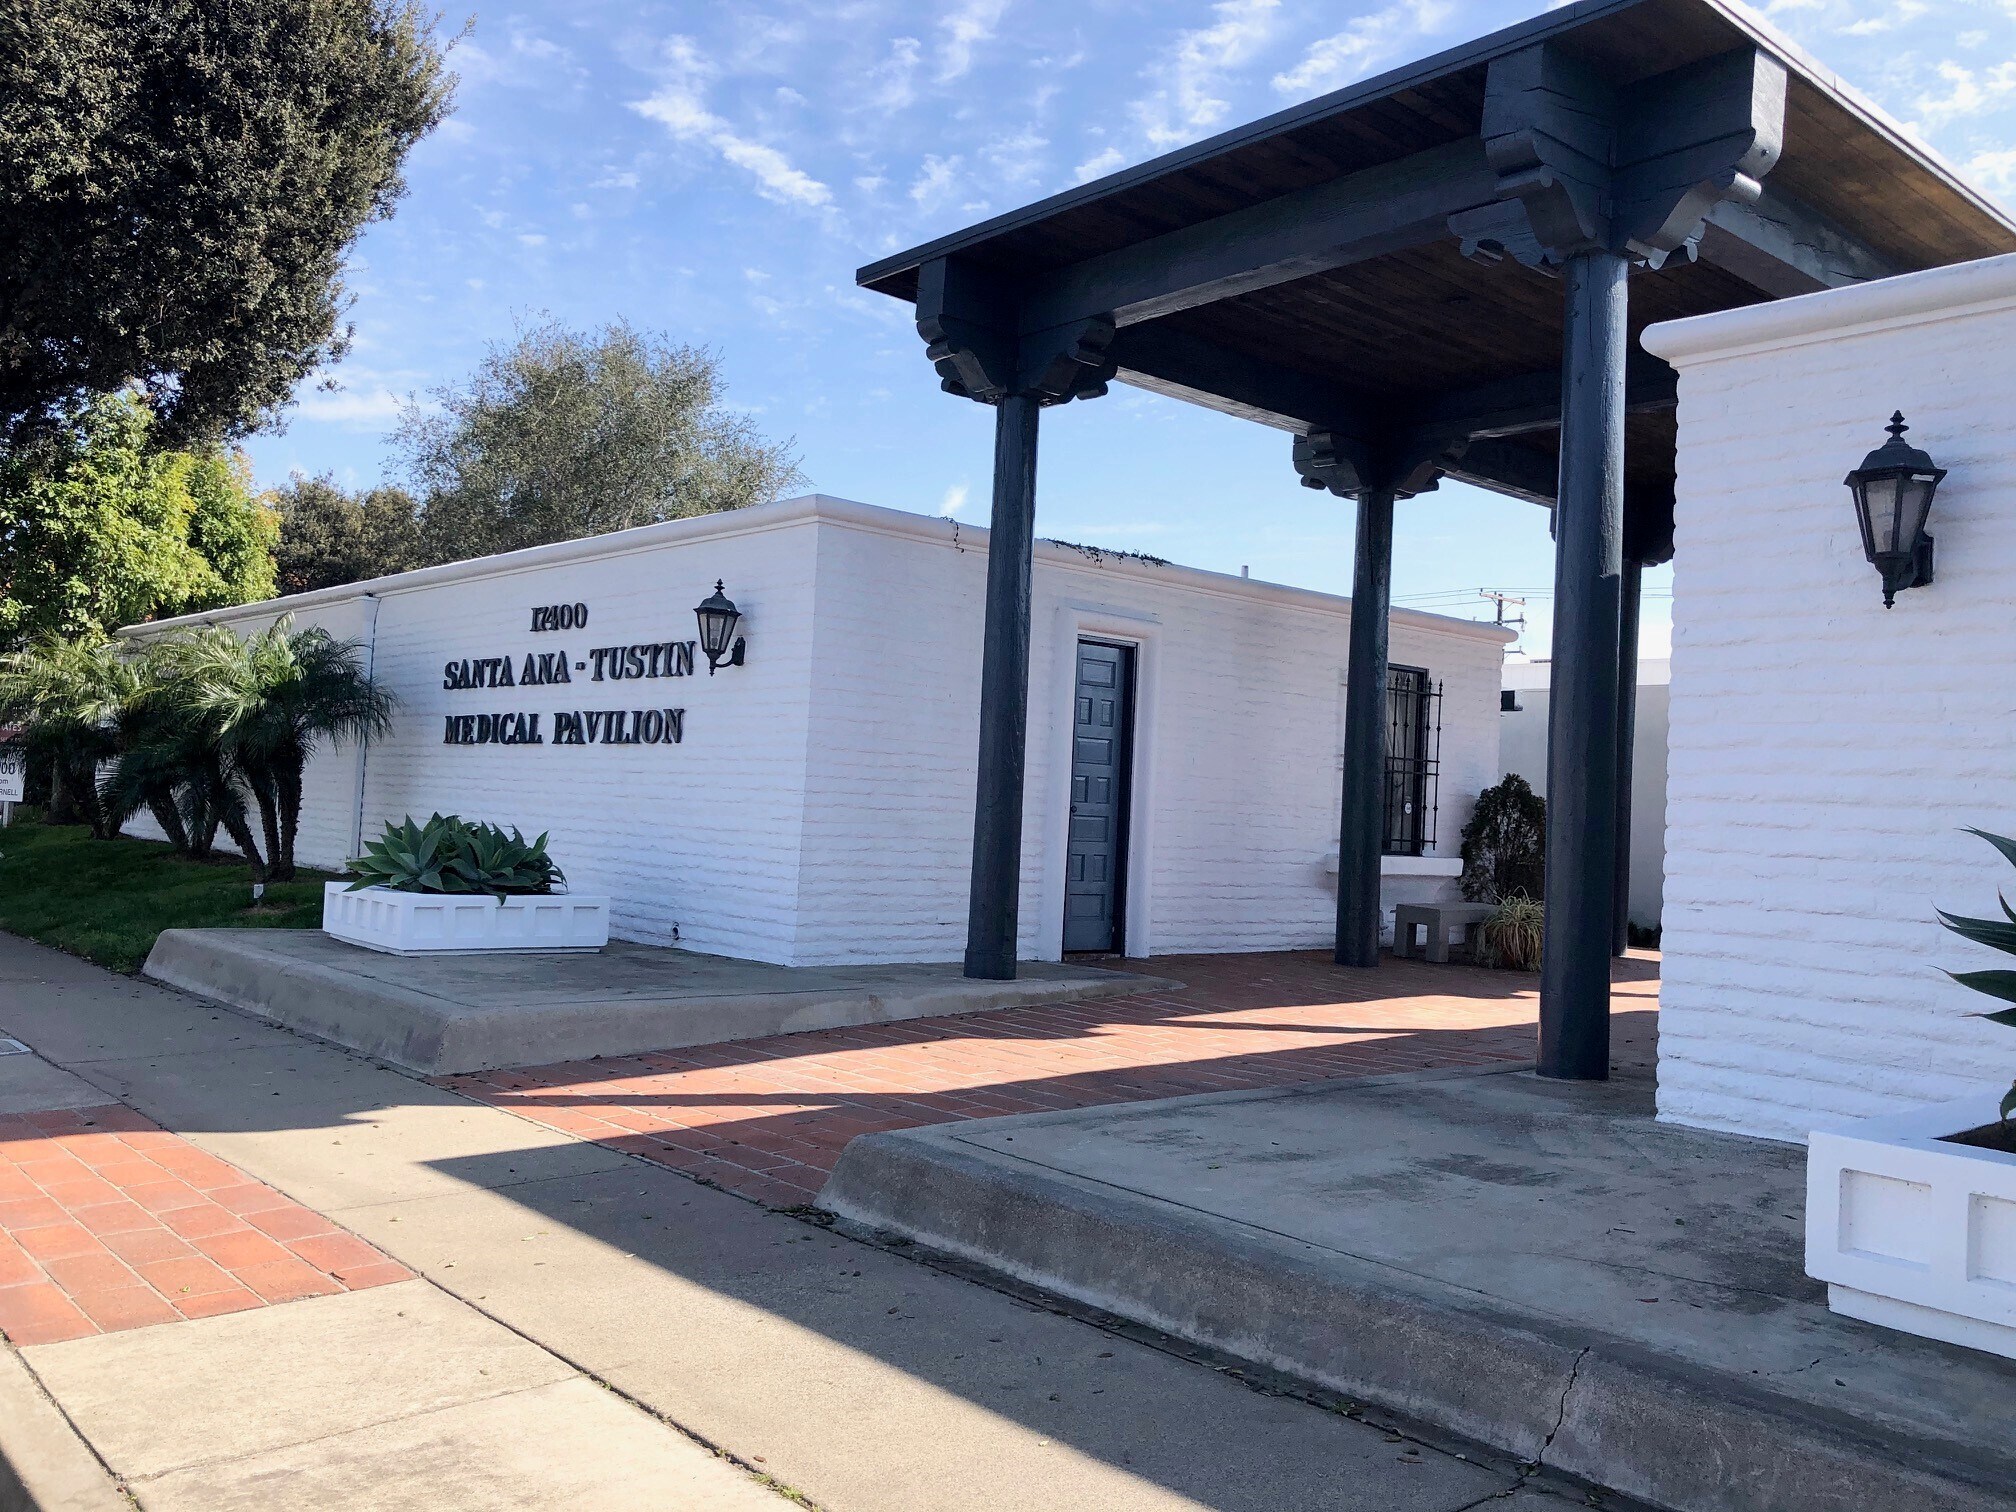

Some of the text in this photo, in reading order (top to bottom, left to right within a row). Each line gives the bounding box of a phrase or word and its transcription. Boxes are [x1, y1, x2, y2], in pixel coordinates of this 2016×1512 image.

[530, 602, 588, 632] 17400
[443, 656, 515, 689] SANTA
[519, 650, 571, 686] ANA
[589, 640, 696, 681] TUSTIN
[443, 708, 685, 744] MEDICAL PAVILION
